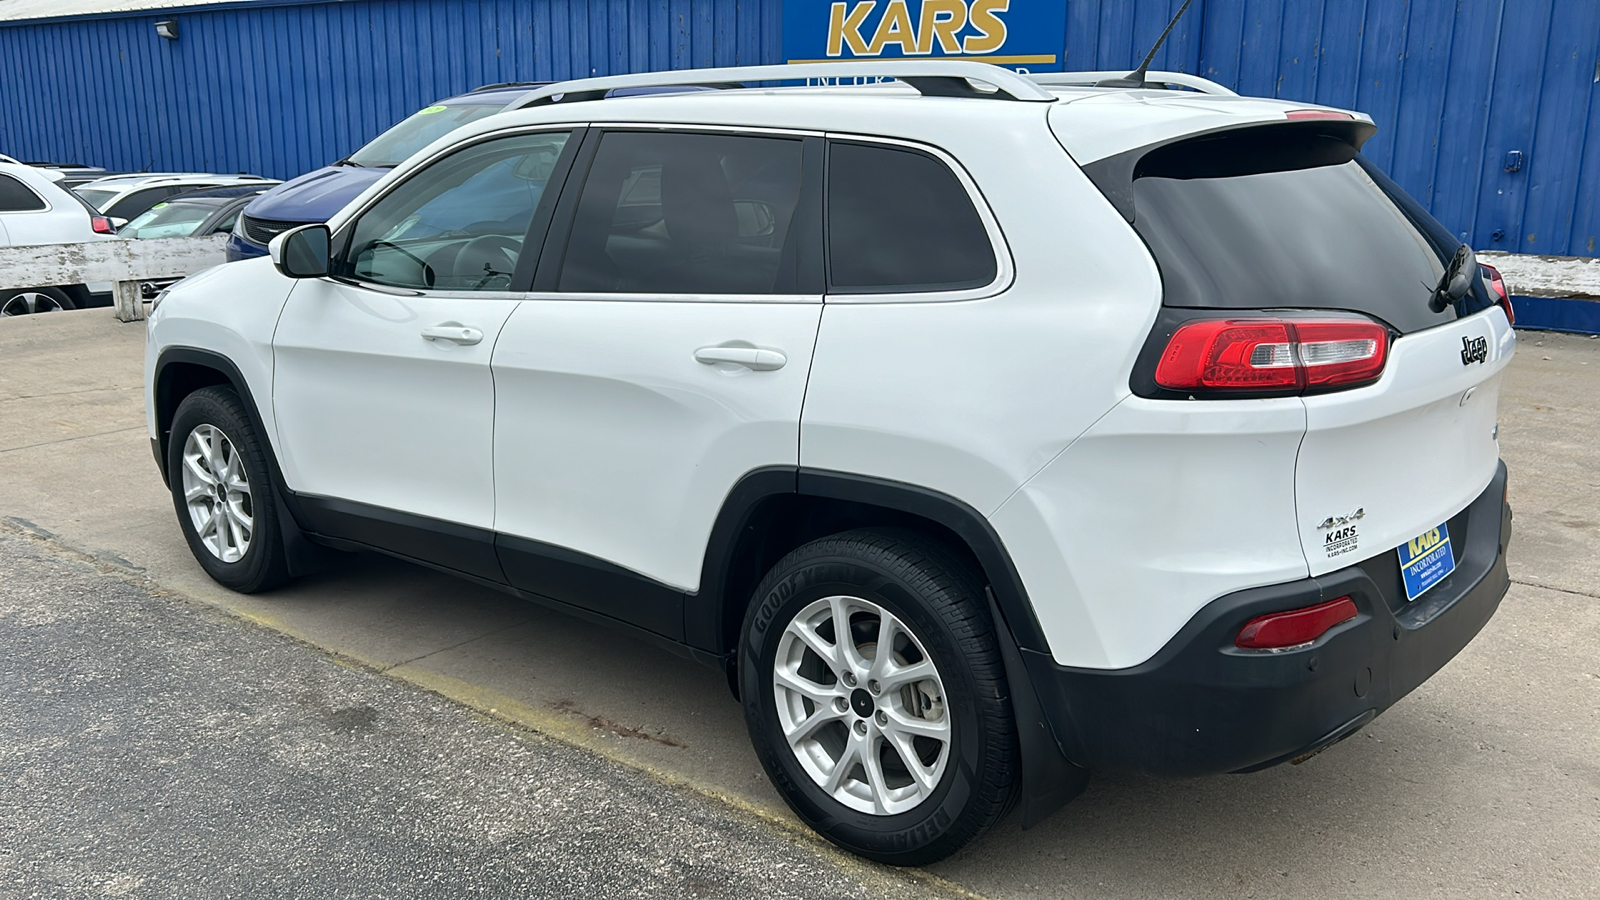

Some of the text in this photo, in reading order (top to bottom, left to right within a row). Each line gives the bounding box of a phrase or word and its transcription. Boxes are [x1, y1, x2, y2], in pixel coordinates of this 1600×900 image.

[826, 1, 1010, 56] KARS
[1461, 336, 1488, 366] Jeep
[1325, 525, 1356, 544] KARS
[1326, 537, 1358, 552] INCORPORATED
[1410, 546, 1447, 576] INCORPORATED
